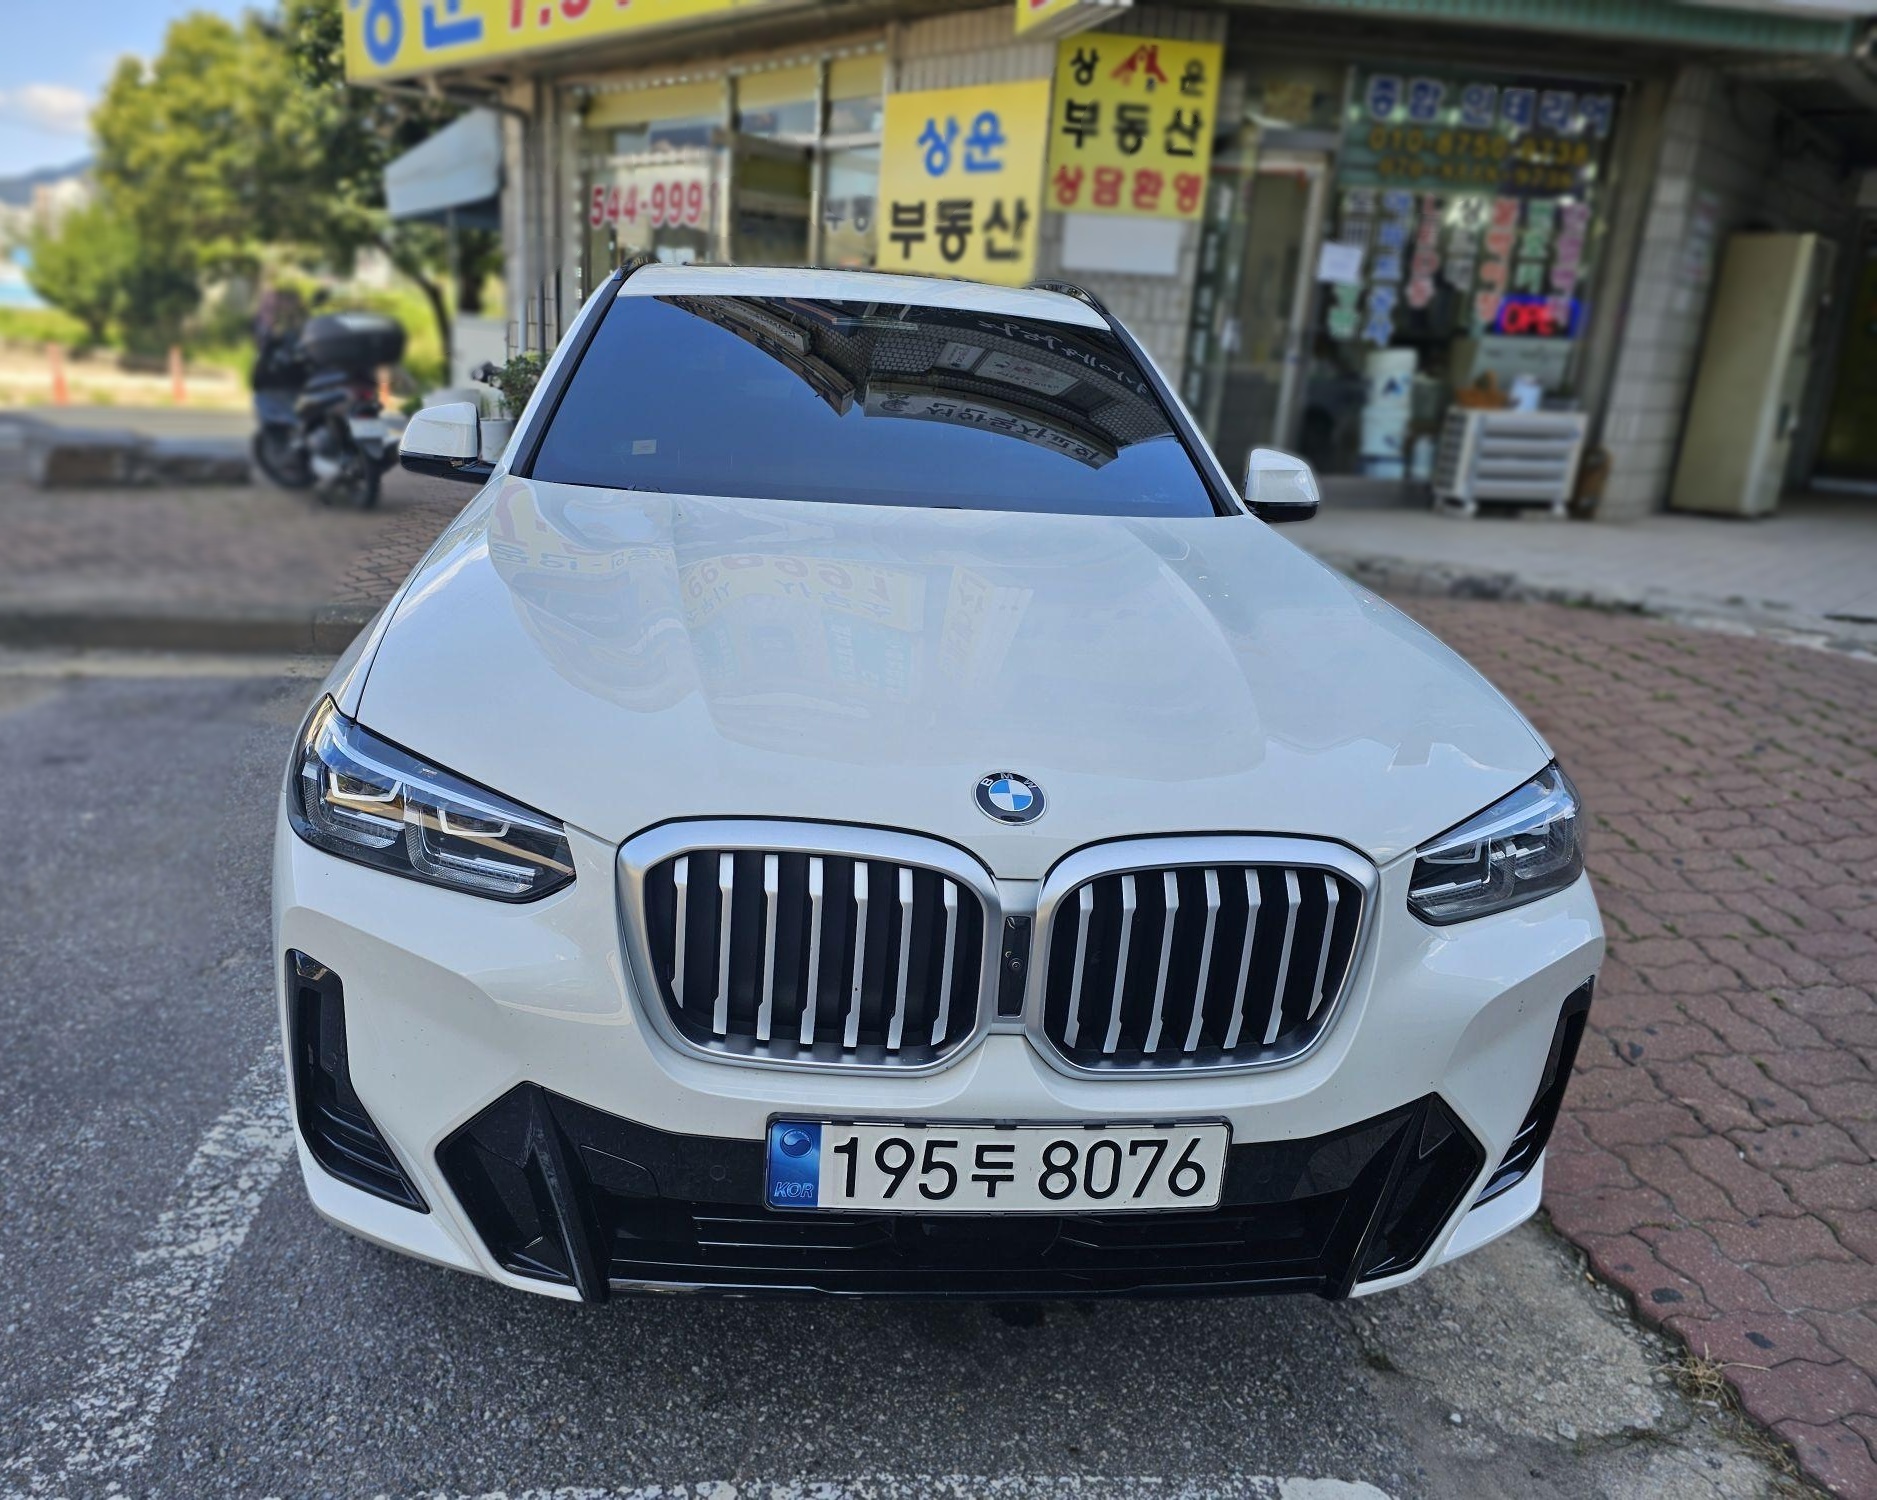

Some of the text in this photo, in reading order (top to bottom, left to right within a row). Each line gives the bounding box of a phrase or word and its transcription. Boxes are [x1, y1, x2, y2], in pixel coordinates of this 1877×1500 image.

[918, 111, 1006, 177] 상운
[1062, 98, 1203, 158] 부동산
[889, 197, 1030, 264] 부동산
[980, 771, 1037, 790] BMW
[774, 1181, 814, 1198] KOR
[833, 1135, 1207, 1201] 195두 8076
